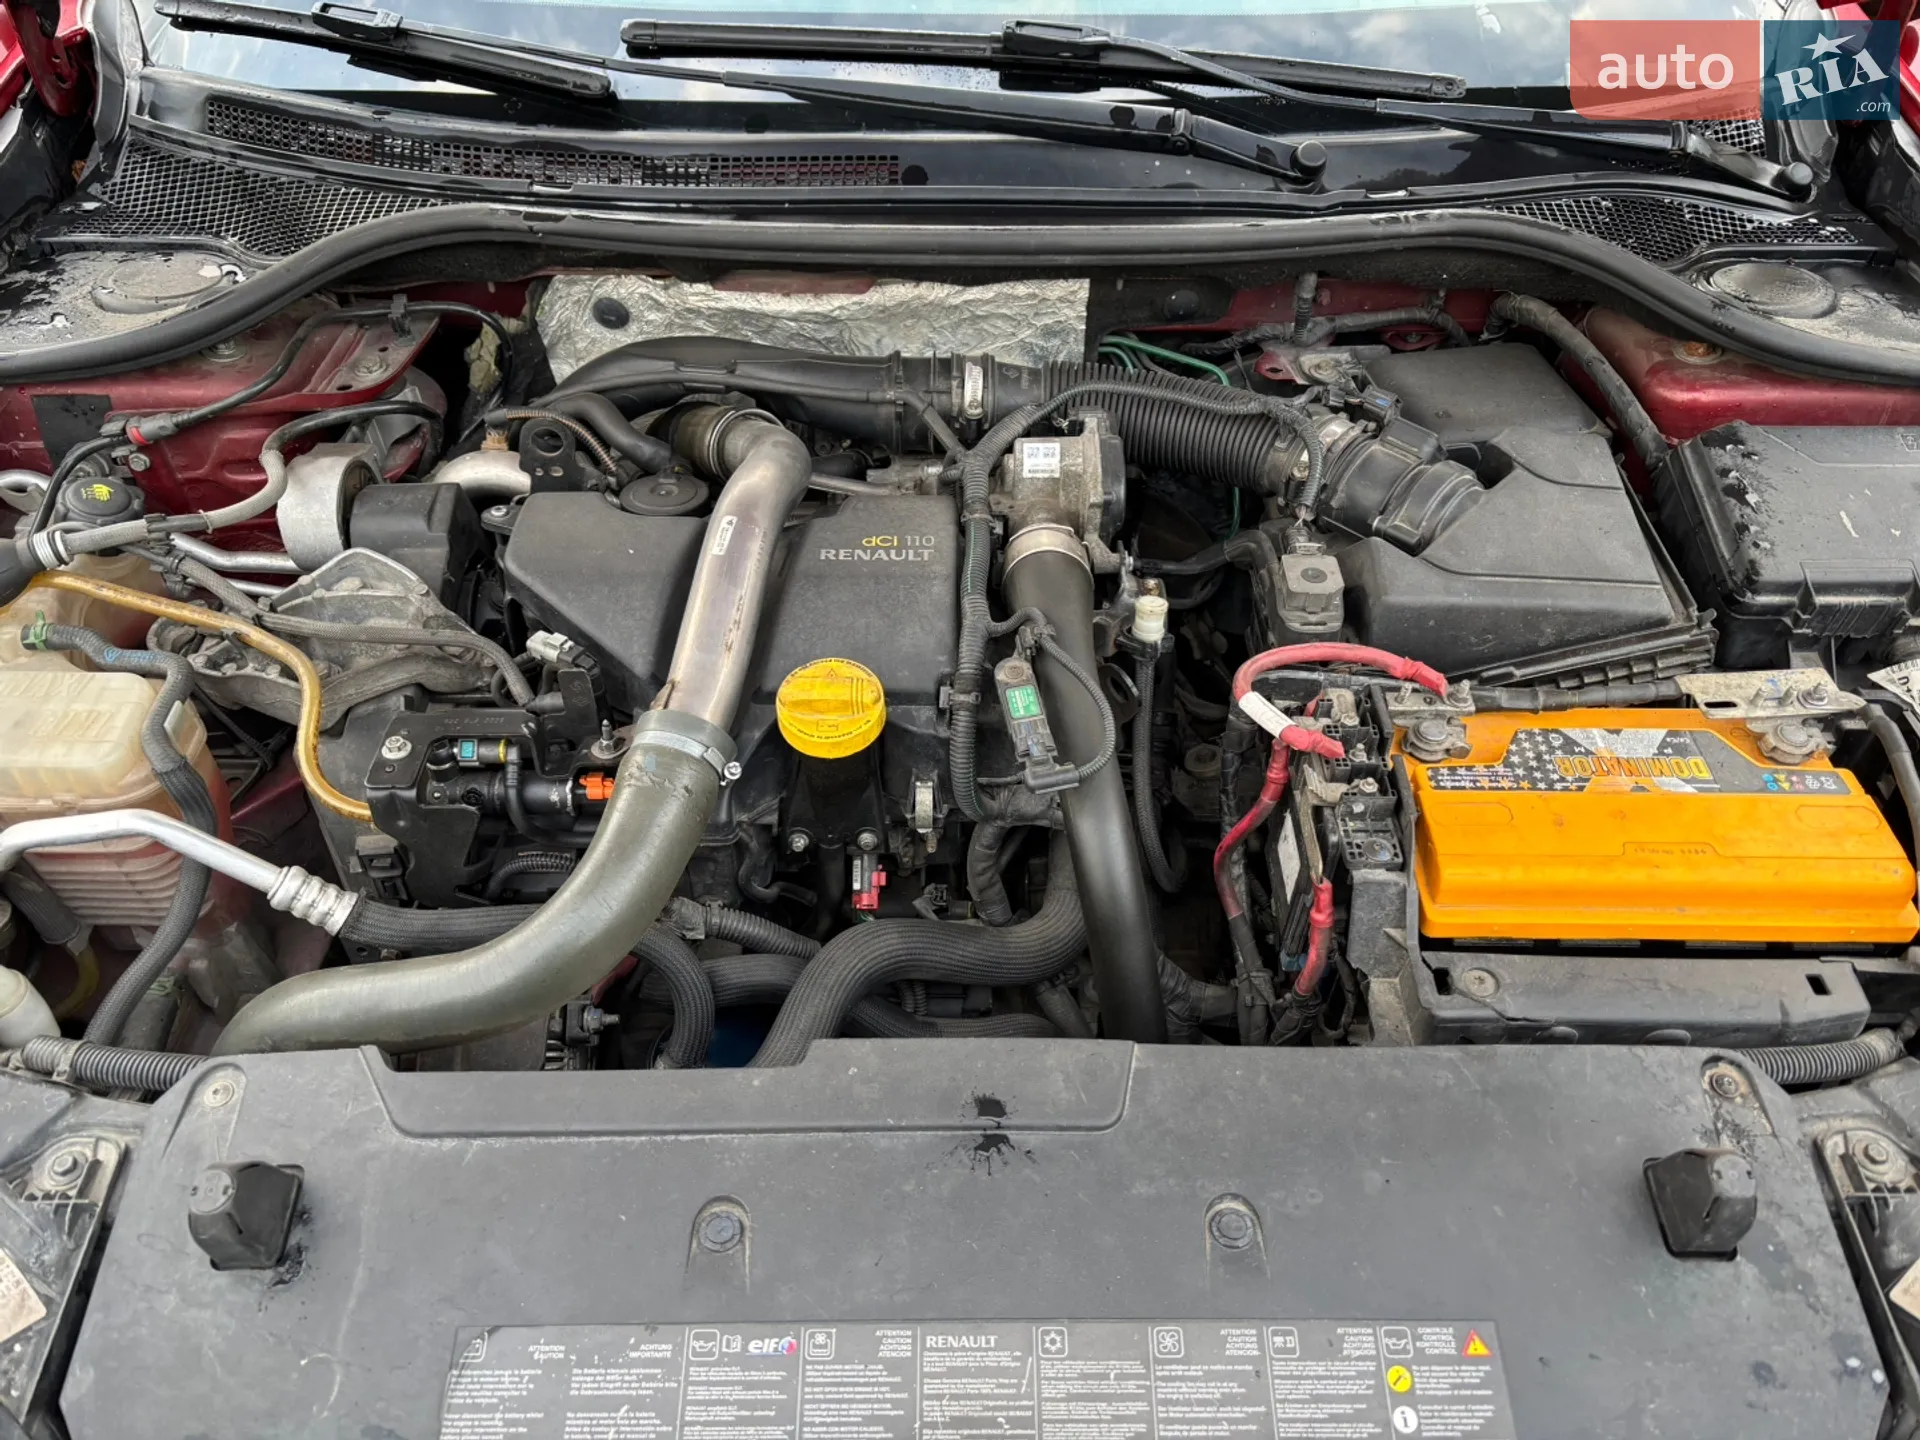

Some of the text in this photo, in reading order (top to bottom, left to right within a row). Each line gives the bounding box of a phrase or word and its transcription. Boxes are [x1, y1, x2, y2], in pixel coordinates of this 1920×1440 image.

[905, 535, 935, 547] 110
[819, 548, 935, 561] RENAULT
[1552, 757, 1713, 779] DOMINATOR
[748, 1337, 779, 1354] elf
[926, 1336, 998, 1348] RENAULT
